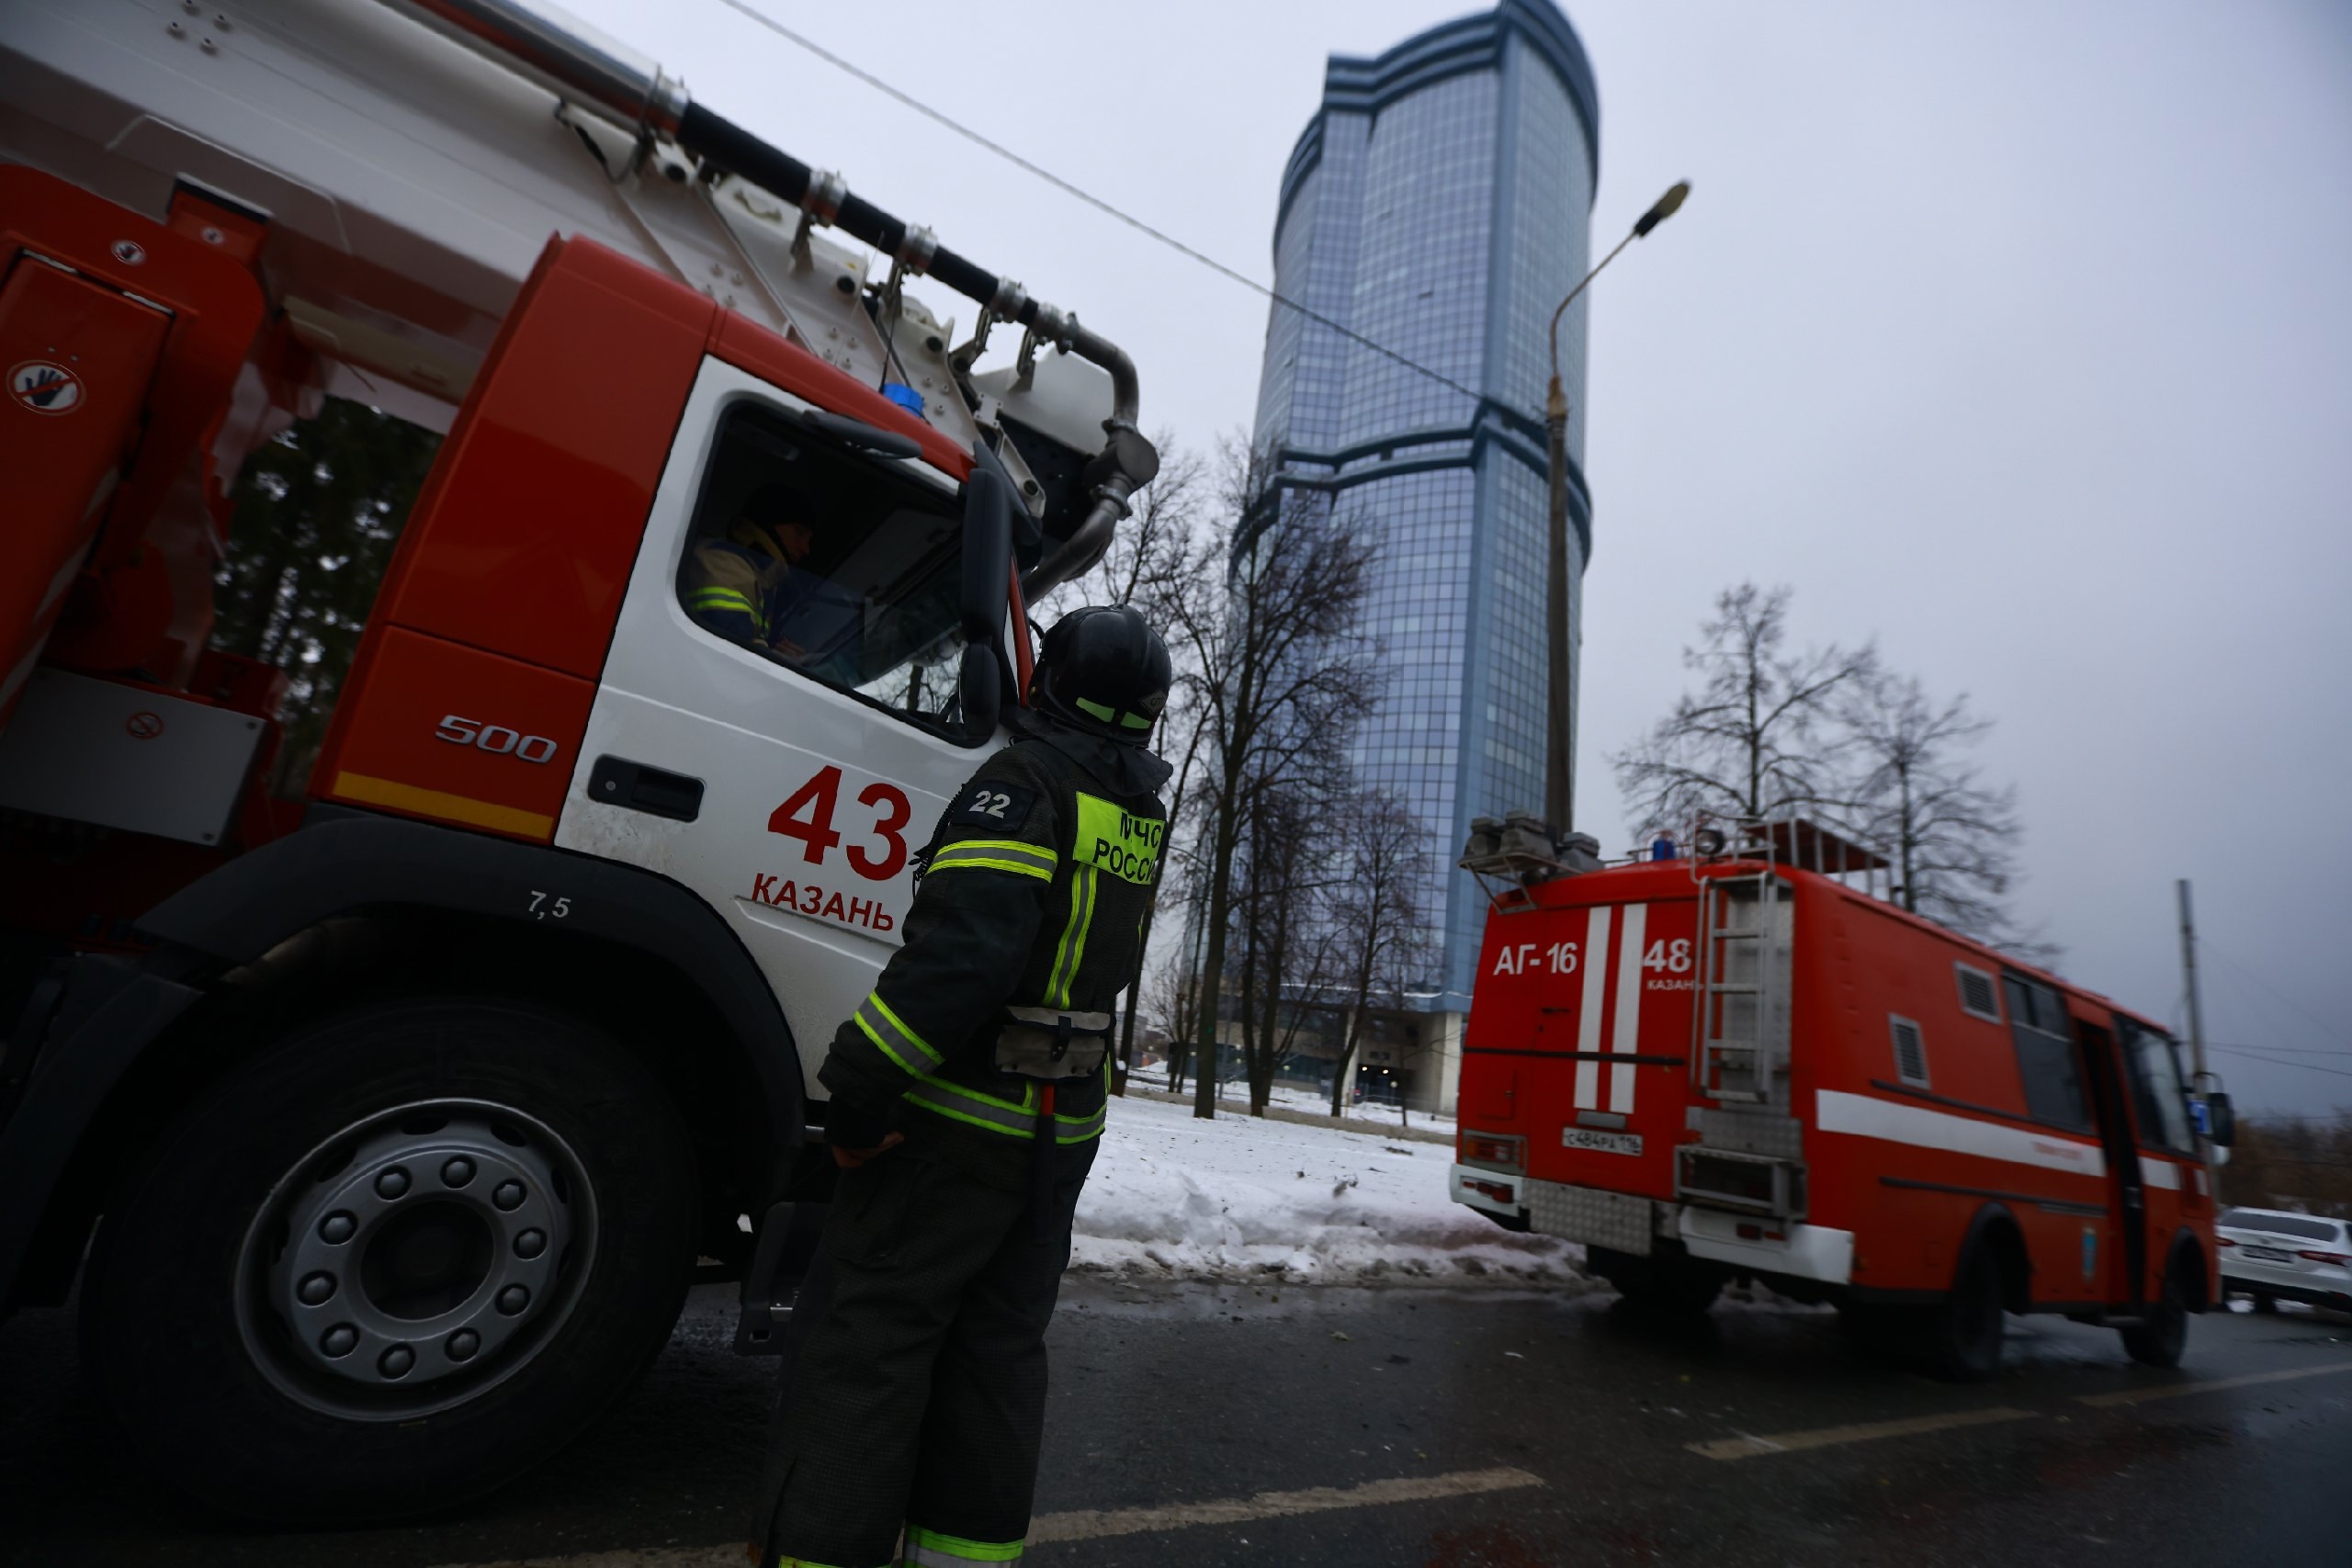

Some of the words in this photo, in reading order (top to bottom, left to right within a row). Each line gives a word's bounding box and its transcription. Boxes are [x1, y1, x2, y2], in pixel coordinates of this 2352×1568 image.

[435, 715, 558, 764] 500
[767, 764, 911, 882] 43
[967, 790, 1012, 819] 22
[527, 890, 571, 920] 7,5
[752, 873, 895, 931] КАЗАНЬ
[1643, 938, 1692, 974] 48
